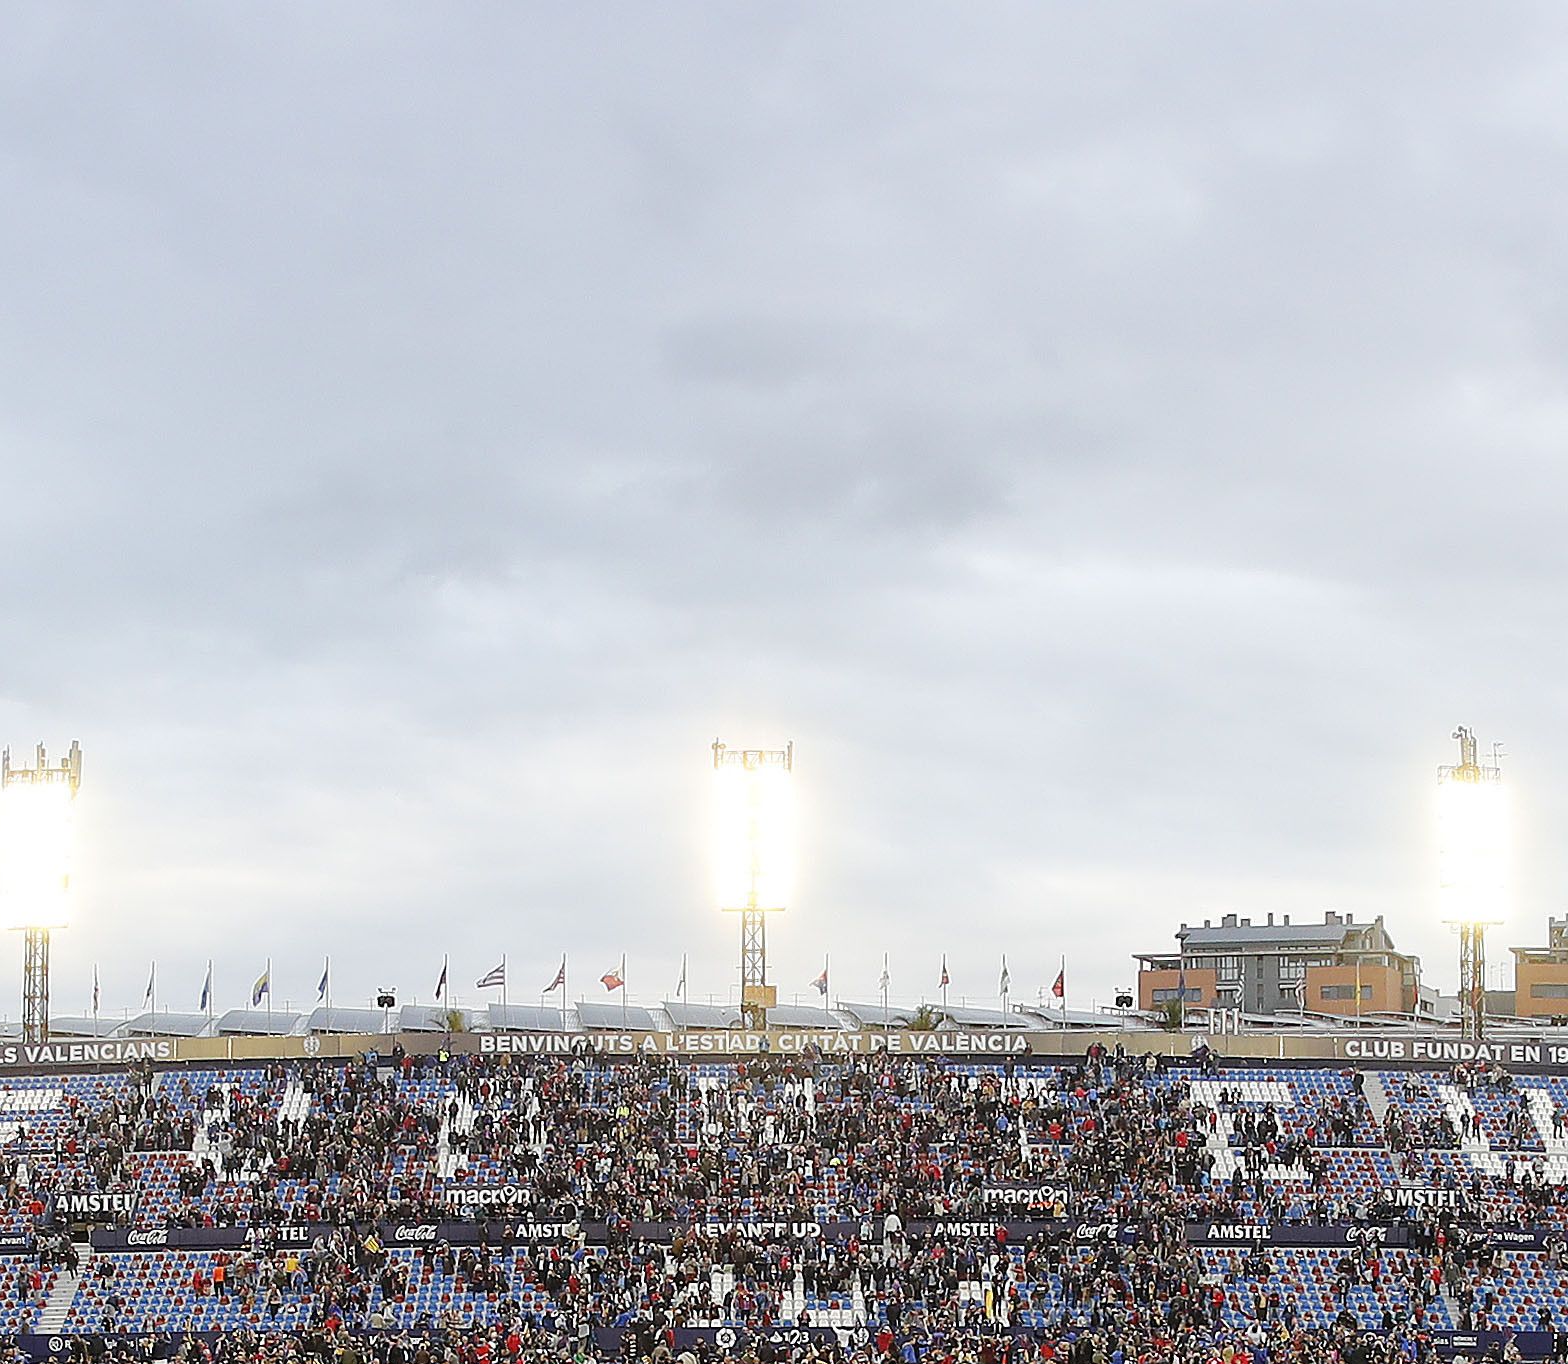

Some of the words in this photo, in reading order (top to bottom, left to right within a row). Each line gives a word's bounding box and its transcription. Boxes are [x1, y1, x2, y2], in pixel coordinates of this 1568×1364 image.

[642, 1034, 657, 1051] A
[666, 1034, 768, 1051] L'ESTAD
[870, 1034, 901, 1051] DE
[909, 1031, 1028, 1051] VALÈNCIA
[1345, 1040, 1405, 1058] CLUB
[1412, 1042, 1505, 1061] FUNDAT
[1511, 1046, 1540, 1062] EN
[21, 1041, 170, 1063] VALENCIANS
[1207, 1224, 1271, 1240] AMSTEL
